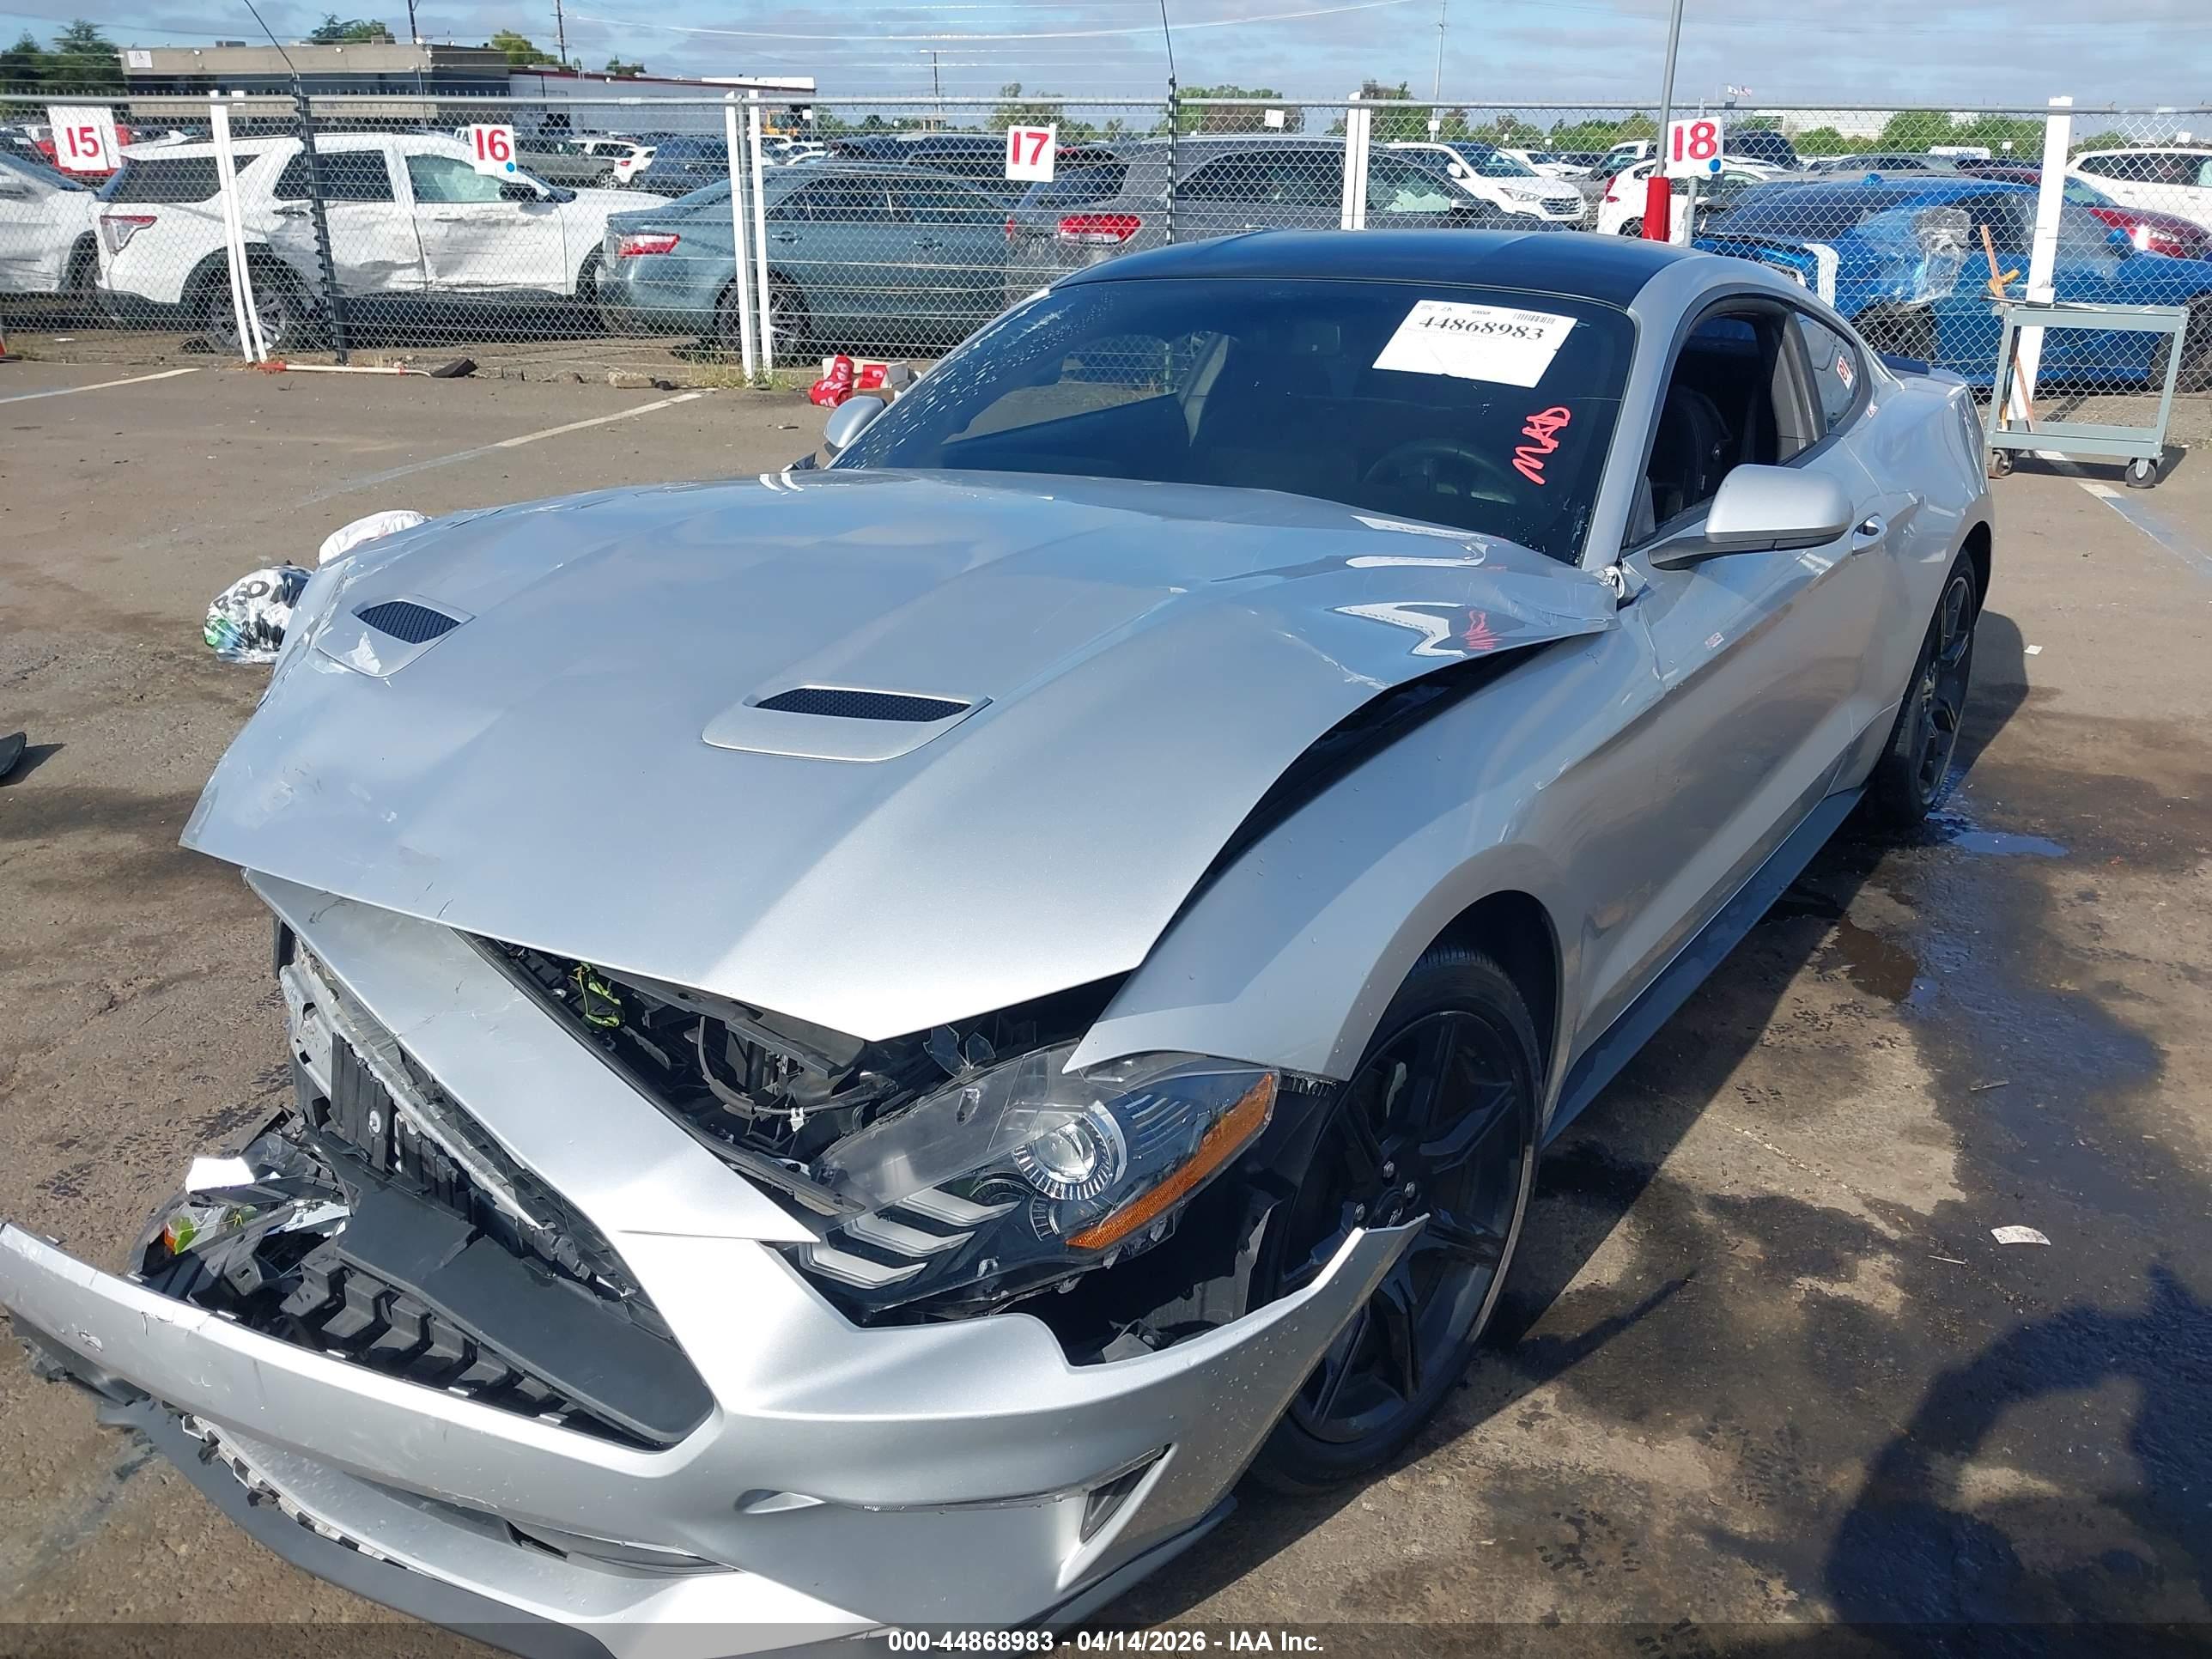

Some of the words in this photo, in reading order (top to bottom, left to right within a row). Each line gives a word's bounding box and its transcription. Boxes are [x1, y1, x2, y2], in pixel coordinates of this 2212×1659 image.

[66, 126, 100, 158] 15
[476, 129, 510, 161] 16
[1012, 131, 1049, 166] 17
[1673, 121, 1717, 163] 18
[1419, 315, 1545, 341] 44868983
